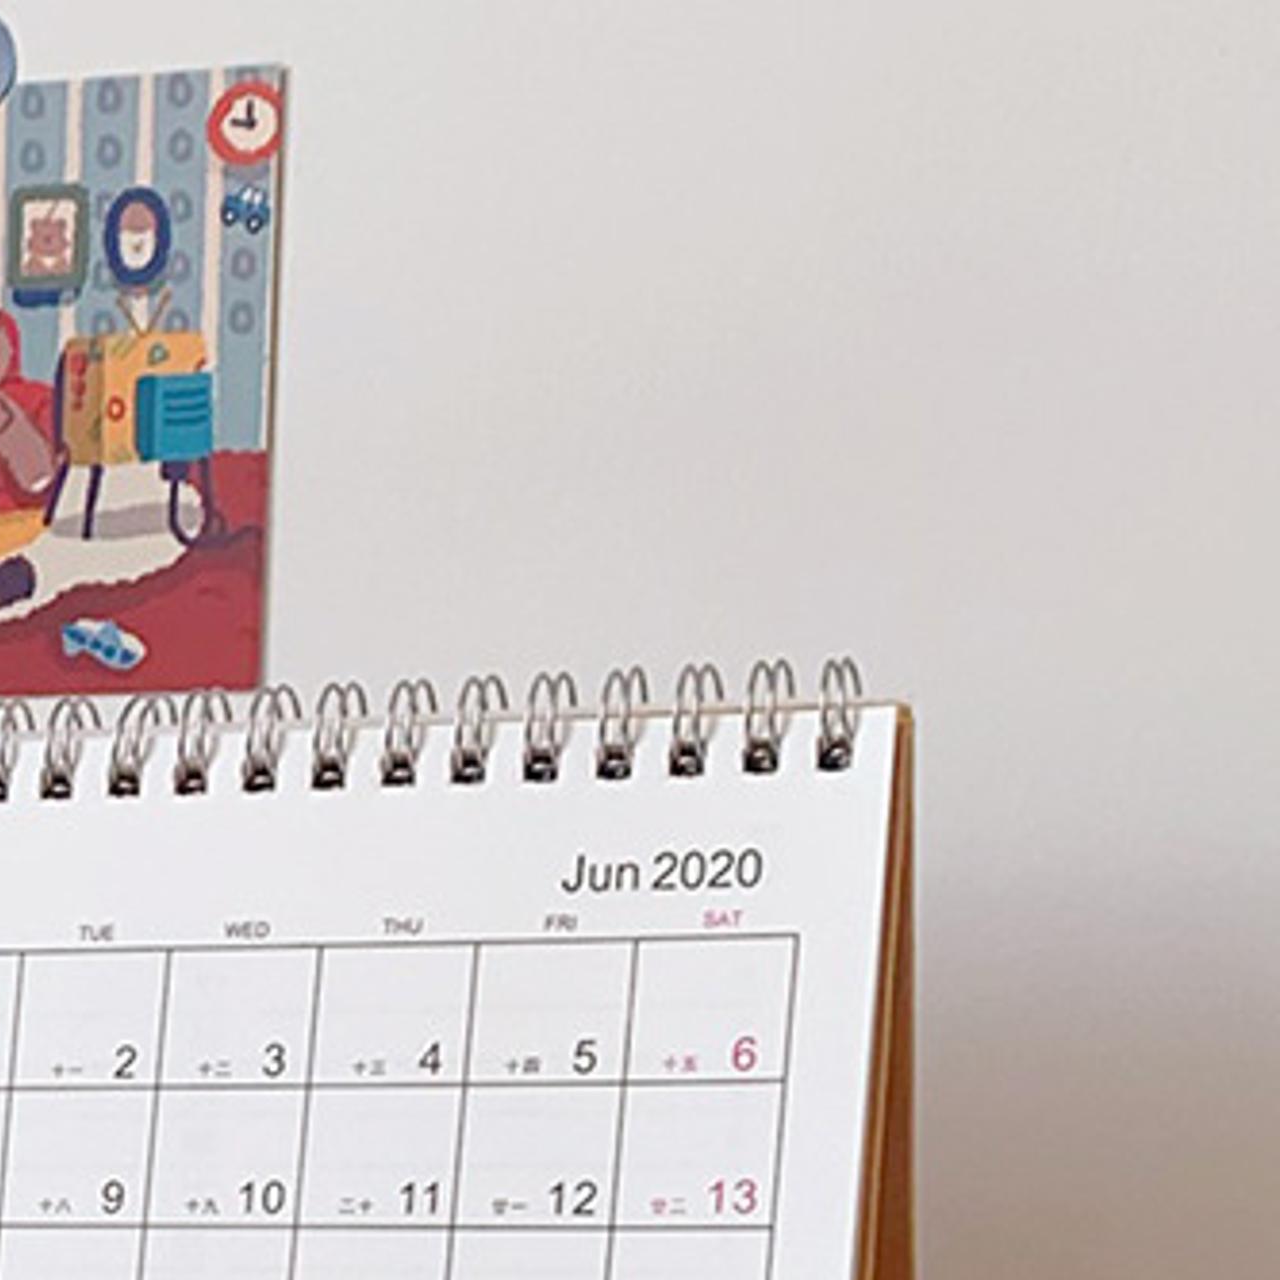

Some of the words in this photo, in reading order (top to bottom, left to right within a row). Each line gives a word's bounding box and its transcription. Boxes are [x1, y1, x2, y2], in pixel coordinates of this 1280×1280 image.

[561, 854, 640, 894] Jun
[651, 847, 763, 891] 2020
[79, 924, 114, 942] TUE
[224, 920, 271, 940] WED
[383, 917, 424, 936] THU
[544, 913, 578, 931] FRI
[703, 909, 743, 929] SAT
[114, 1044, 137, 1080] 2
[262, 1042, 286, 1079] 3
[418, 1042, 441, 1075] 4
[572, 1039, 598, 1076] 5
[731, 1035, 757, 1072] 6
[101, 1179, 125, 1215] 9
[239, 1179, 286, 1215] 10
[400, 1181, 439, 1215] 11
[550, 1180, 598, 1217] 12
[709, 1178, 757, 1215] 13
